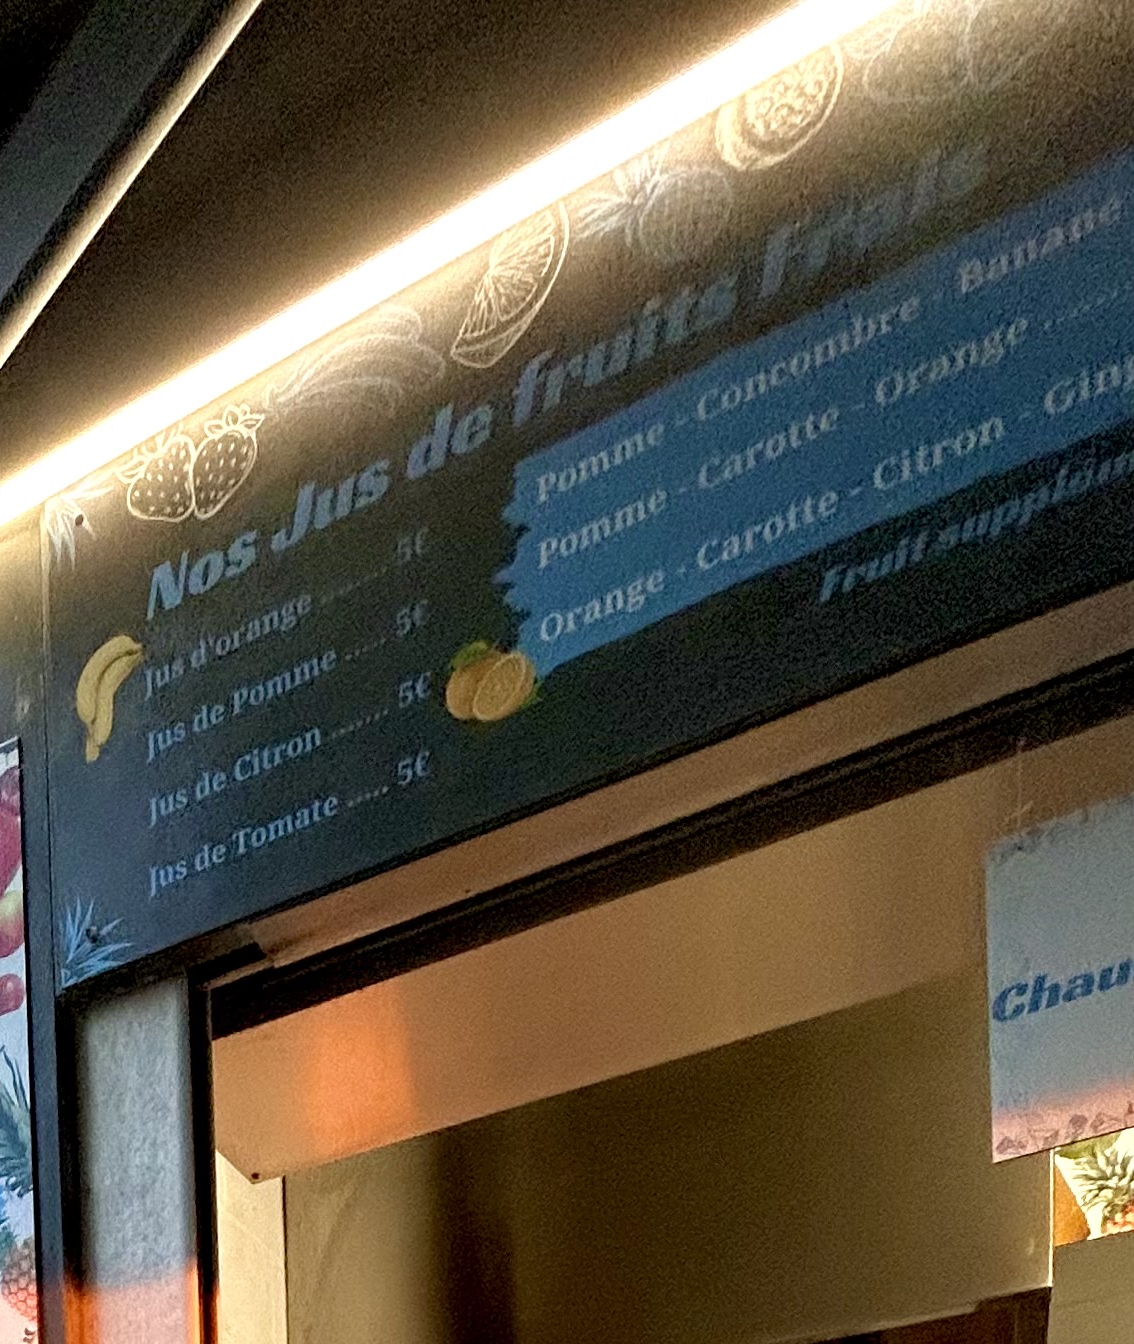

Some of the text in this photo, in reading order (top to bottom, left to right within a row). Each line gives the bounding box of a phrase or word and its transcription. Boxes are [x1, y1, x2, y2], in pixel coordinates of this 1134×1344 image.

[146, 528, 261, 621] Nos
[271, 460, 390, 551] Jus
[407, 405, 494, 479] de
[513, 272, 738, 427] fruits
[536, 422, 665, 501] Pomme
[696, 294, 921, 422] Concombre
[536, 315, 1029, 569] Pomme Carotte Orange
[144, 528, 429, 699] Jus d'orange 5€
[538, 566, 667, 644] Orange
[696, 490, 841, 571] Carotte
[872, 414, 1005, 491] Citron
[146, 603, 427, 763] Jus de Pomme 5€
[147, 672, 431, 826] Jus de Citron 5€
[148, 752, 429, 896] Jus de Tomate 5€
[992, 957, 1132, 1022] Chau
